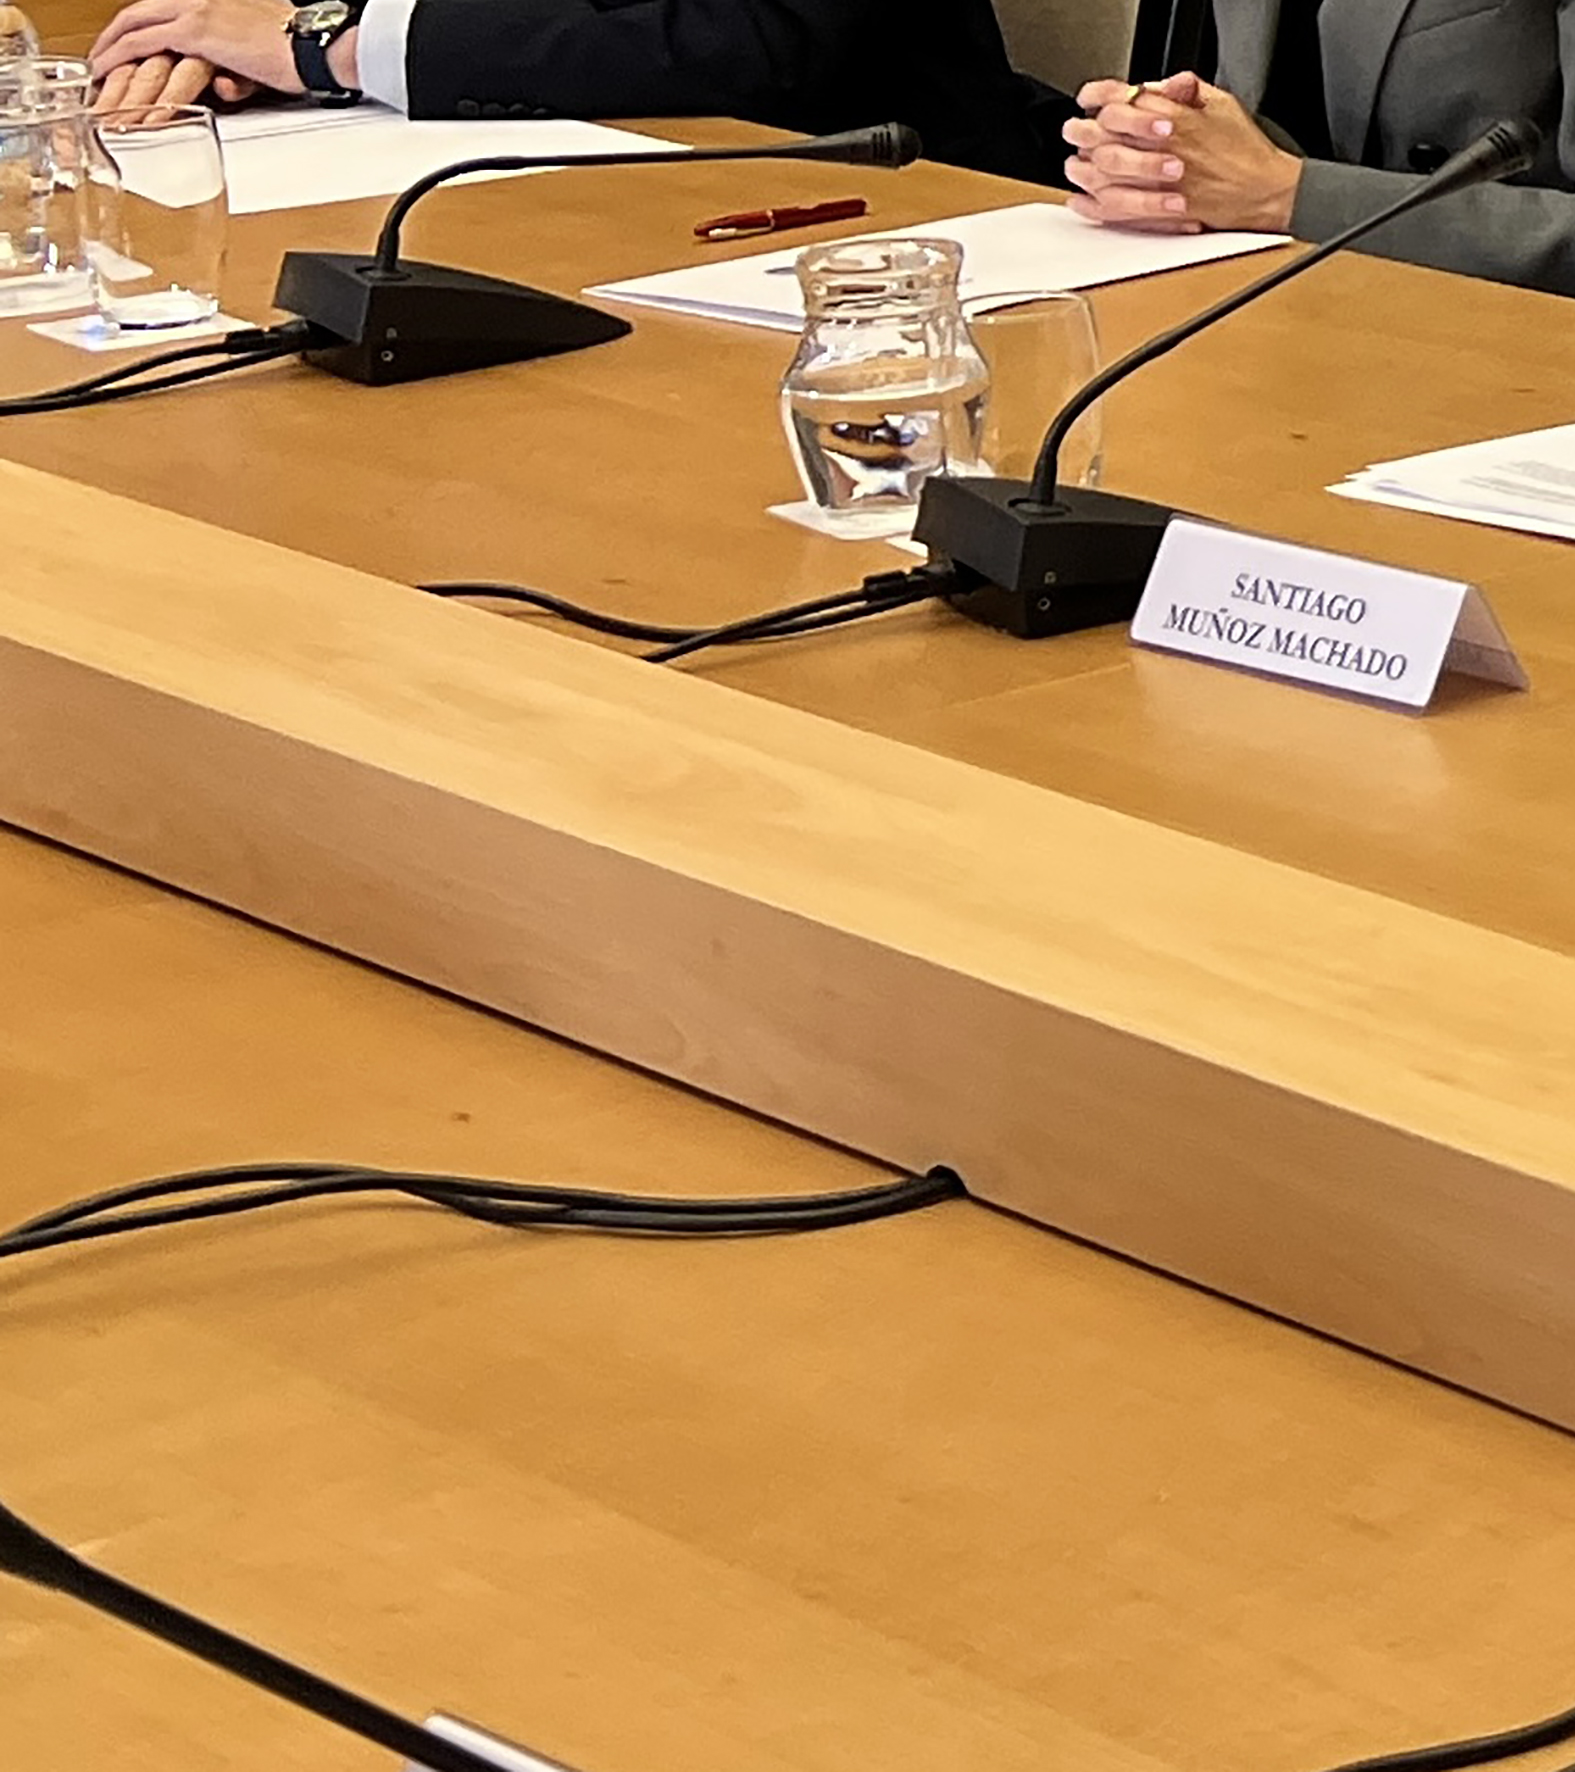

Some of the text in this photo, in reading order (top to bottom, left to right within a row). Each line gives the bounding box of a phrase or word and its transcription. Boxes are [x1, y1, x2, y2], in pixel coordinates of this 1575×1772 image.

[1231, 572, 1367, 625] SANTIAGO
[1163, 604, 1408, 681] MUÑOZ MACHADO
